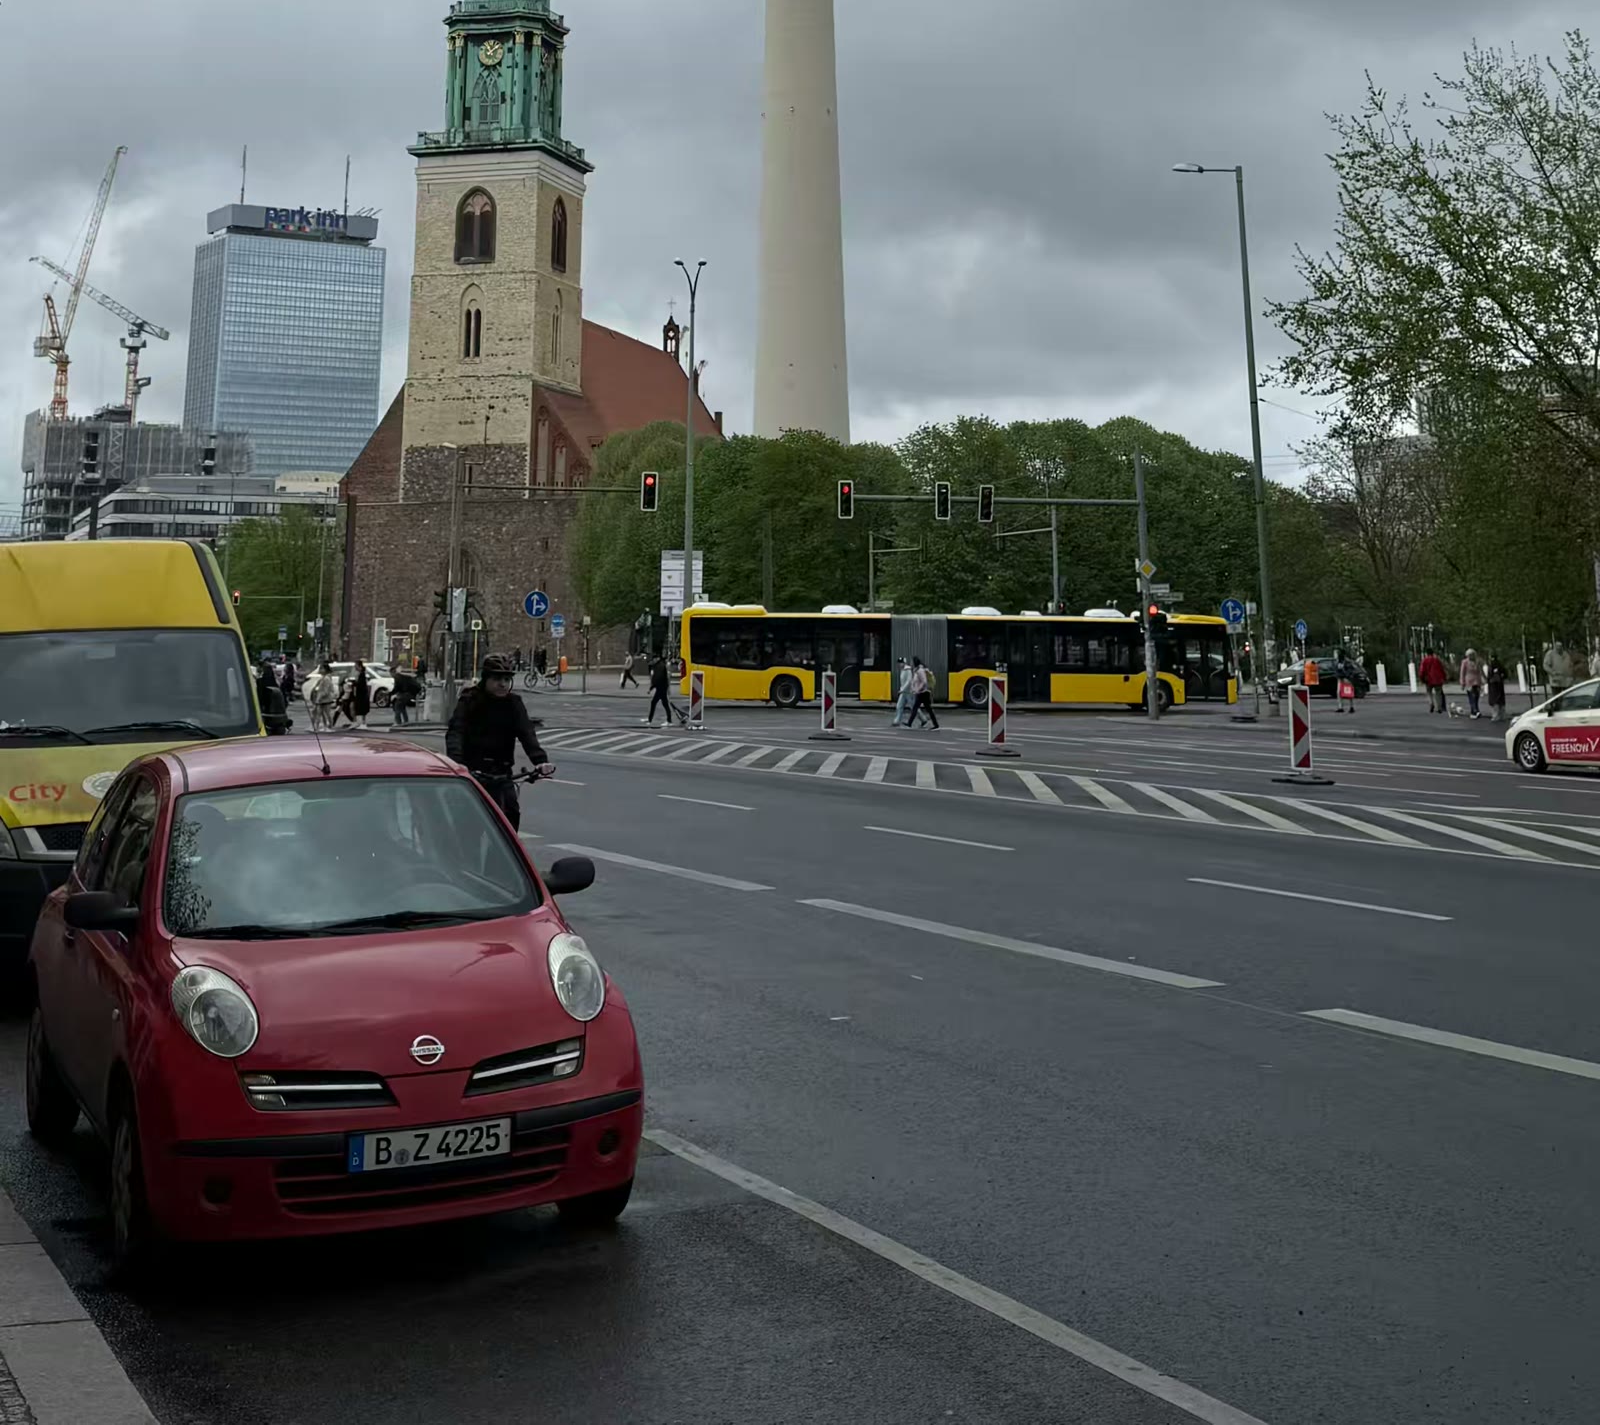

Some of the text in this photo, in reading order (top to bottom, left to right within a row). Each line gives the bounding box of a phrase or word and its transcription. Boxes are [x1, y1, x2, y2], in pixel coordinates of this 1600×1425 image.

[264, 206, 348, 230] park inn
[8, 783, 67, 803] City
[412, 1046, 442, 1054] NISSAN
[375, 1136, 393, 1165] B
[352, 1156, 360, 1166] D
